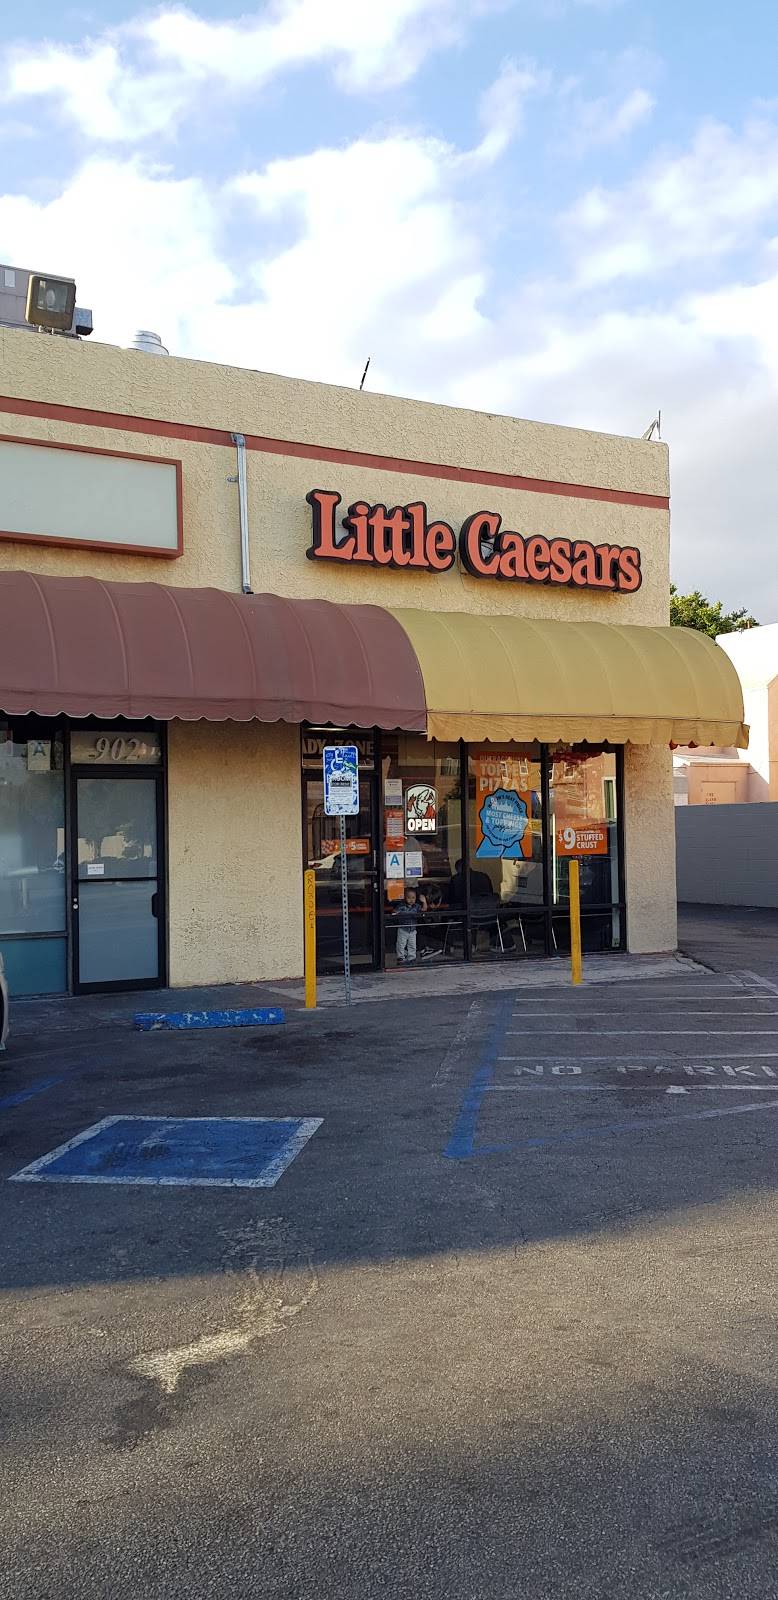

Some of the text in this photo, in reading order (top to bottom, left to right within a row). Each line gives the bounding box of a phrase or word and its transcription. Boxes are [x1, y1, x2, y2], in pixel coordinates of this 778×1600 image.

[309, 490, 641, 592] Little Caesars
[95, 737, 140, 760] 902
[480, 763, 528, 776] TOPE
[407, 818, 436, 831] OPEN
[576, 833, 604, 842] STUFFED
[576, 841, 598, 849] CRUST
[390, 854, 400, 866] A
[513, 1064, 583, 1076] NO
